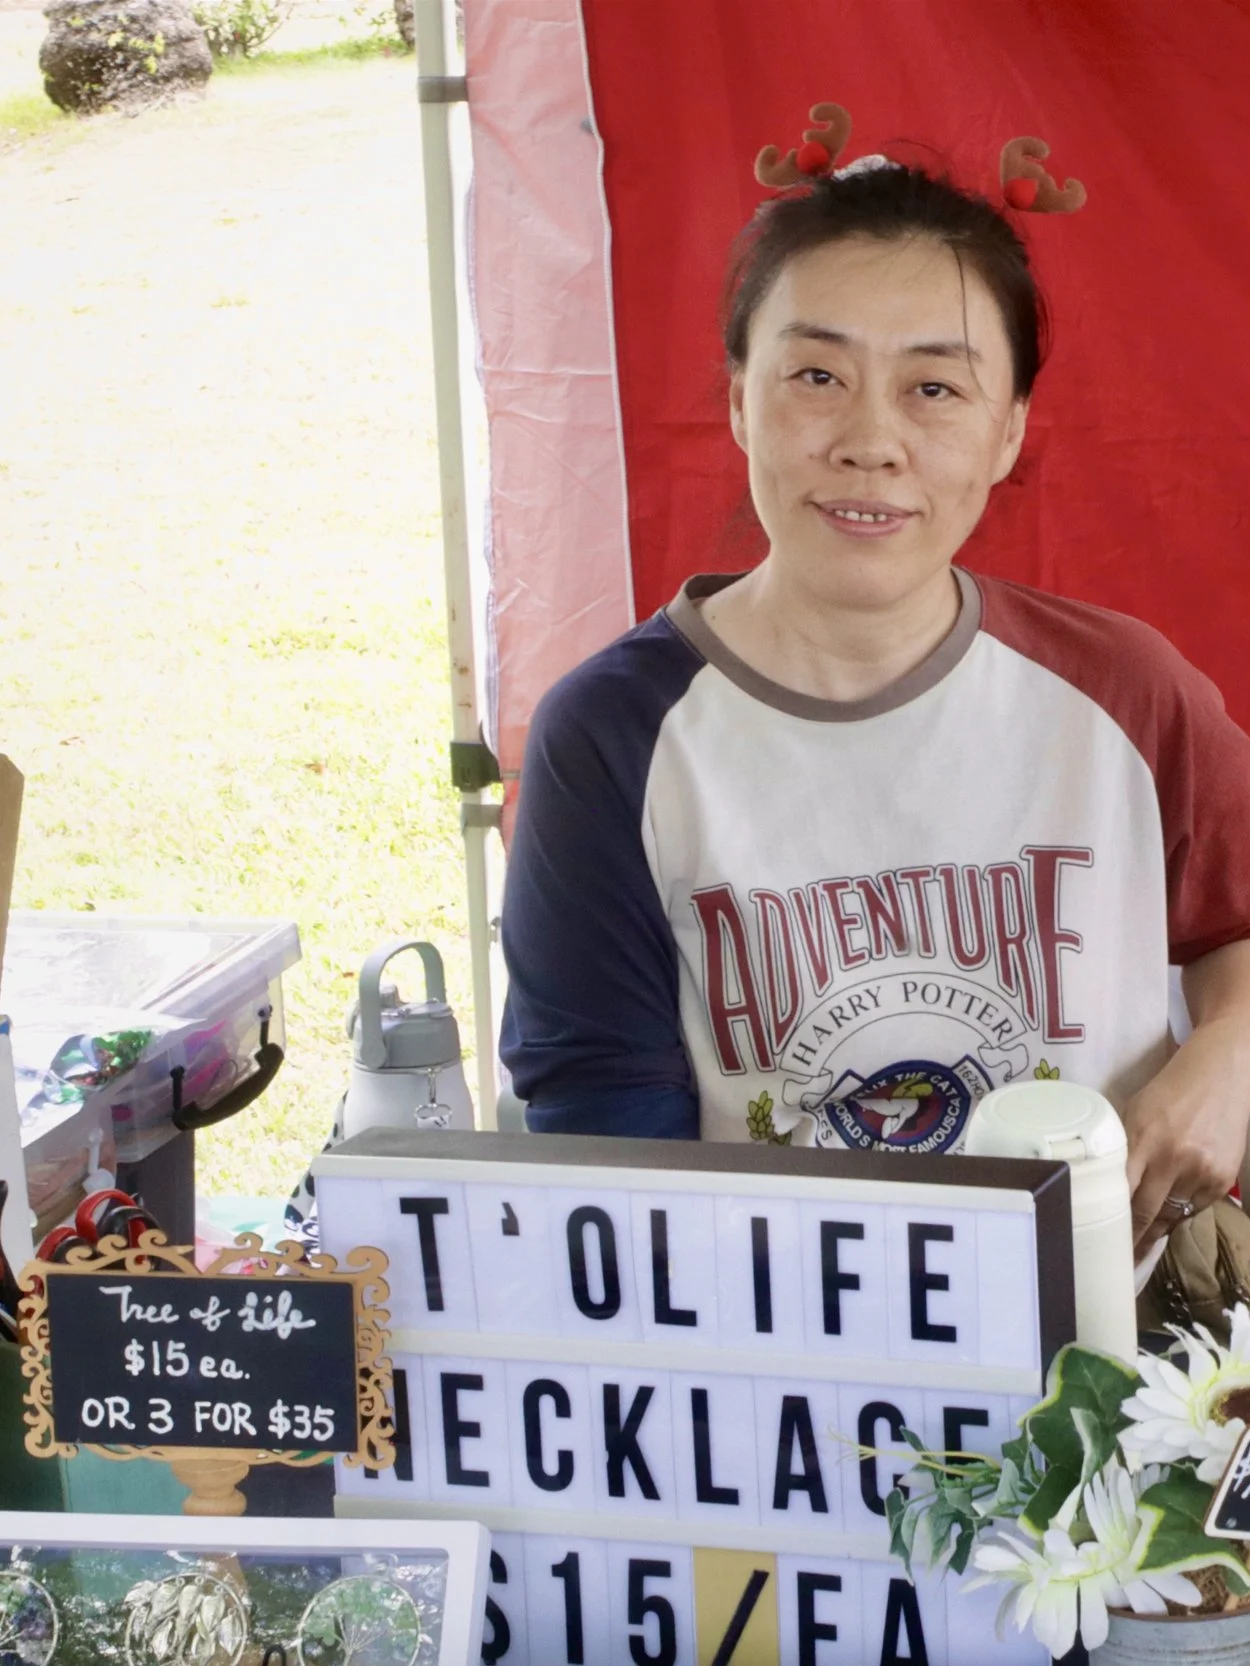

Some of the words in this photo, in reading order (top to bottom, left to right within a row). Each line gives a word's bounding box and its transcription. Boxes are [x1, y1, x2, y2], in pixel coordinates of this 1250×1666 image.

[690, 845, 1094, 1076] ADVENTURE
[791, 986, 882, 1067] HARRY
[902, 980, 1013, 1043] POTTER
[98, 1285, 179, 1323] Tree
[189, 1296, 230, 1331] of
[238, 1290, 316, 1339] Life
[124, 1338, 189, 1376] $15
[200, 1356, 250, 1380] ea.
[81, 1396, 135, 1430] OR
[148, 1398, 174, 1434] 3
[194, 1400, 257, 1436] FOR
[268, 1398, 335, 1441] $35
